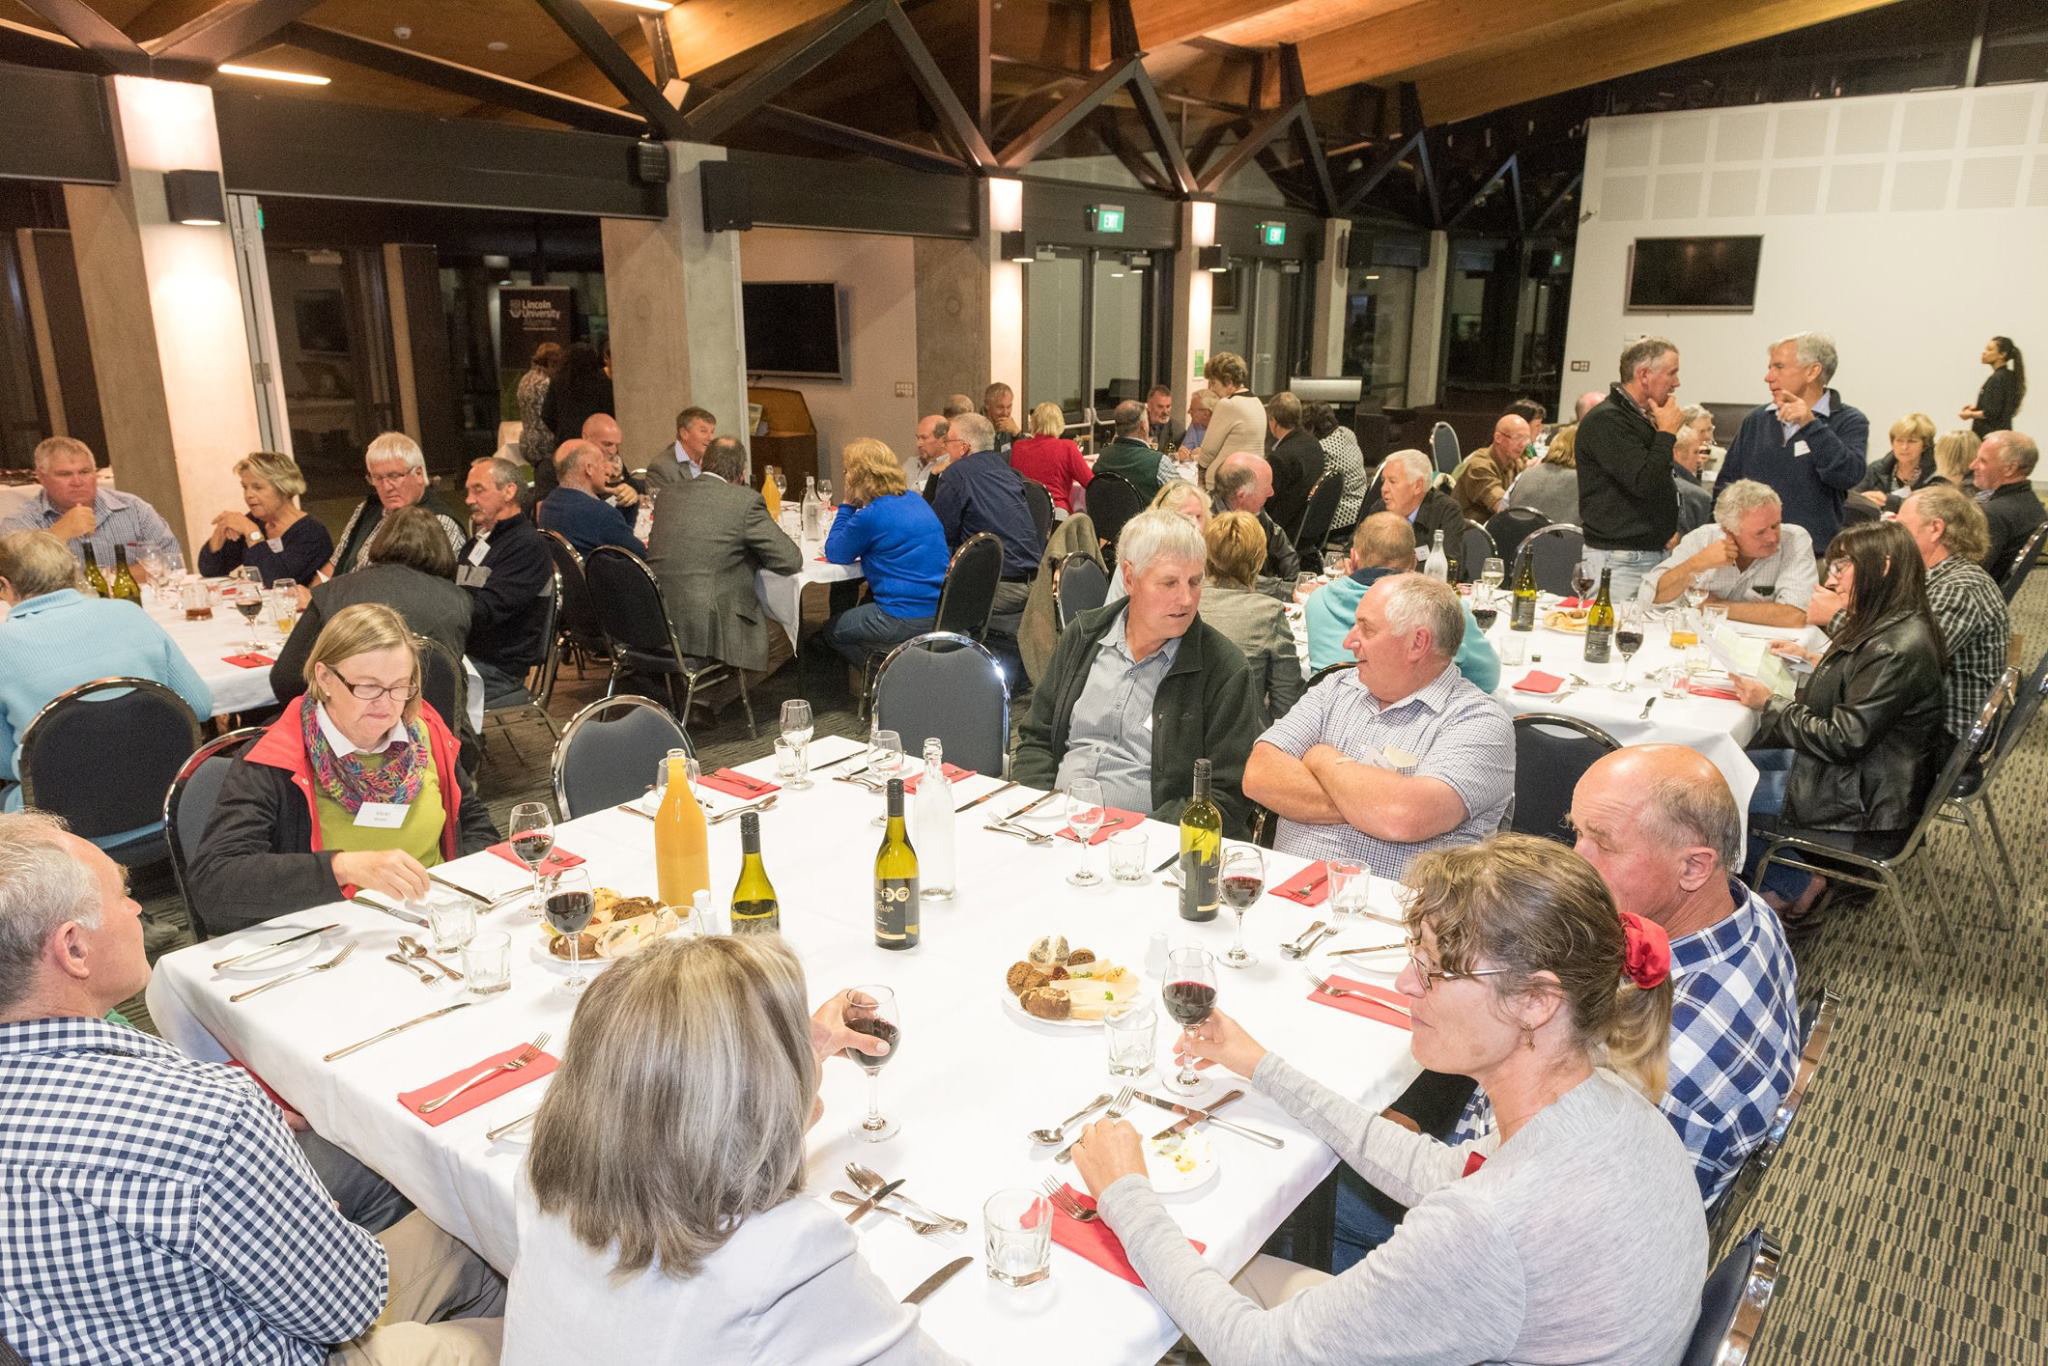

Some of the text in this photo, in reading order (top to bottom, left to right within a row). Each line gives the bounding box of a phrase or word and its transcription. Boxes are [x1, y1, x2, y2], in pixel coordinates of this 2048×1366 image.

[1104, 213, 1120, 228] EXIT
[522, 299, 551, 309] Lincoln
[522, 309, 560, 320] University
